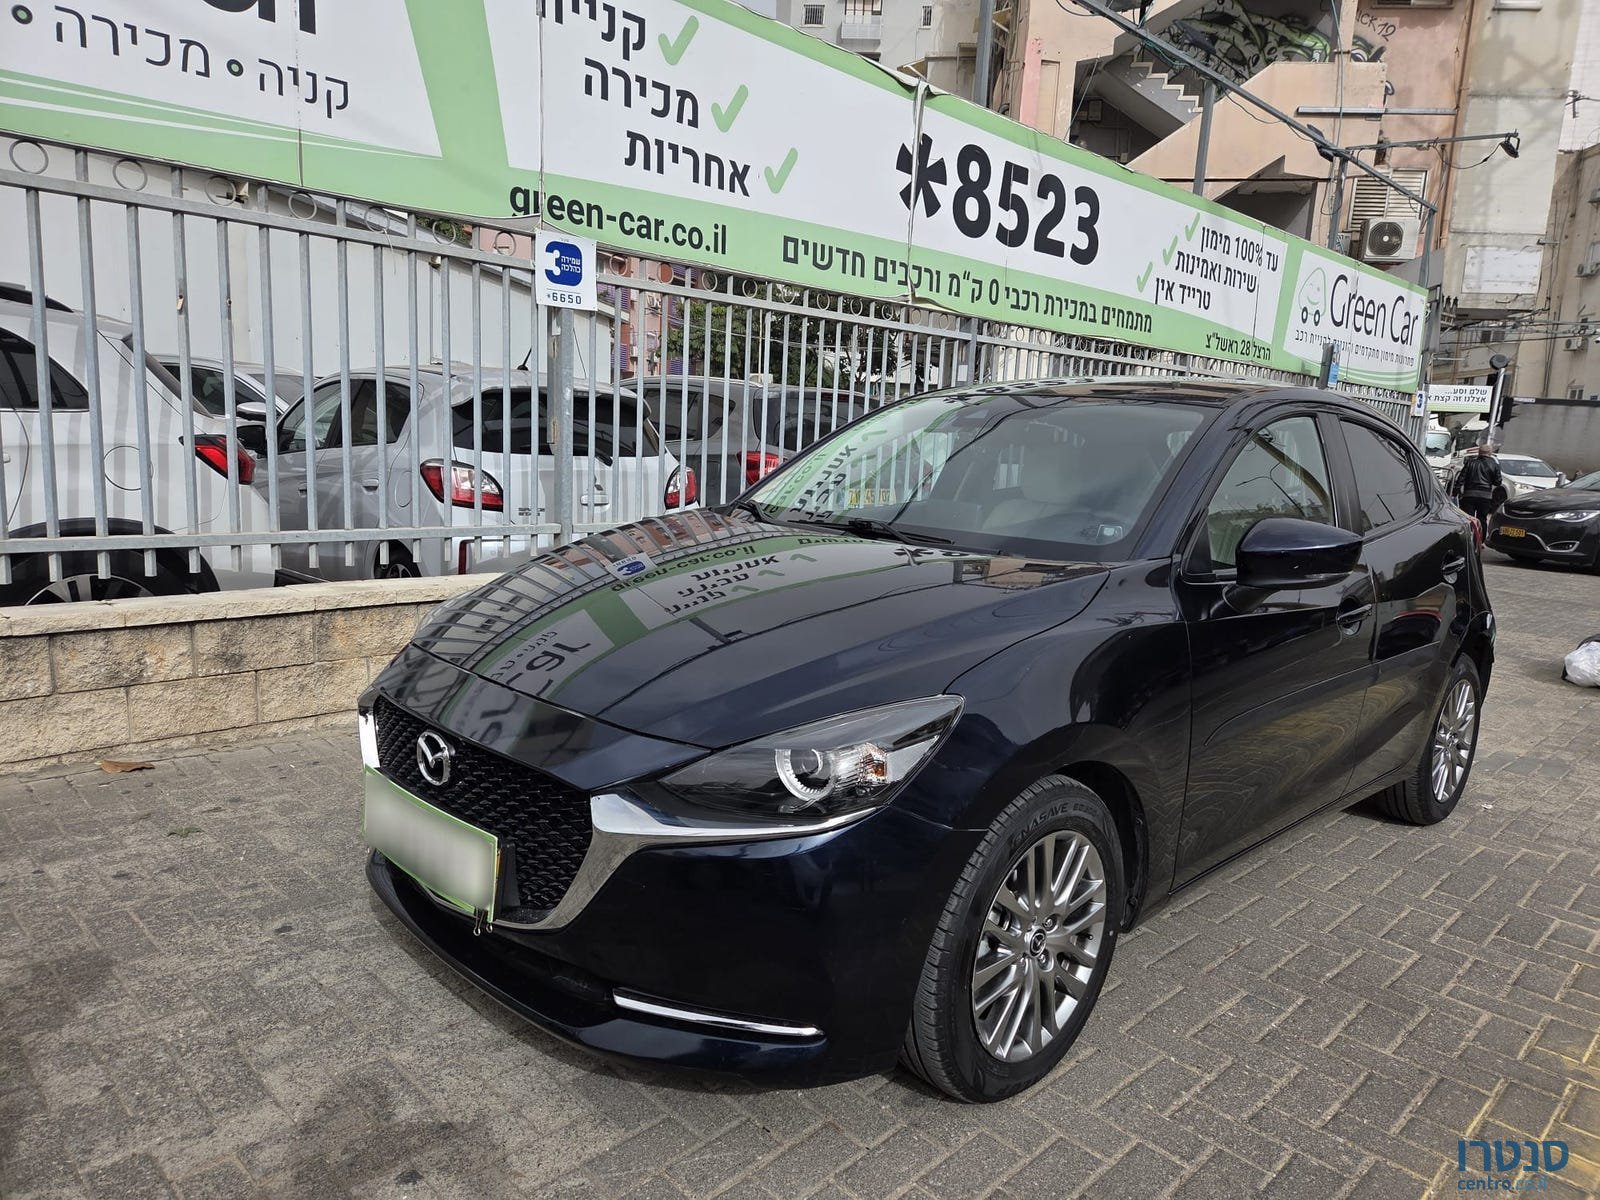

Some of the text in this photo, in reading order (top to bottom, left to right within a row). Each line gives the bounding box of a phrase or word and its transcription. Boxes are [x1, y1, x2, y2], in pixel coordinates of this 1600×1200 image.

[54, 5, 211, 79] מכירה
[257, 57, 350, 119] קניה
[584, 57, 699, 129] מכירה
[624, 129, 751, 198] אחריות
[509, 185, 727, 255] green-car.co.il
[782, 235, 866, 279] חדשים
[1201, 226, 1279, 272] עד 100% מימון
[873, 255, 942, 294] ורכבים
[988, 278, 1000, 306] 0
[1175, 250, 1257, 294] שירות ואמינות
[1004, 286, 1040, 314] רכבי
[1043, 293, 1097, 324] במכירת
[1154, 277, 1211, 311] טרייד אין
[1329, 273, 1419, 346] Green Car
[1101, 305, 1153, 334] מתמחים
[1294, 329, 1308, 343] רכב
[1240, 339, 1251, 357] 28
[1252, 340, 1271, 361] הרצל
